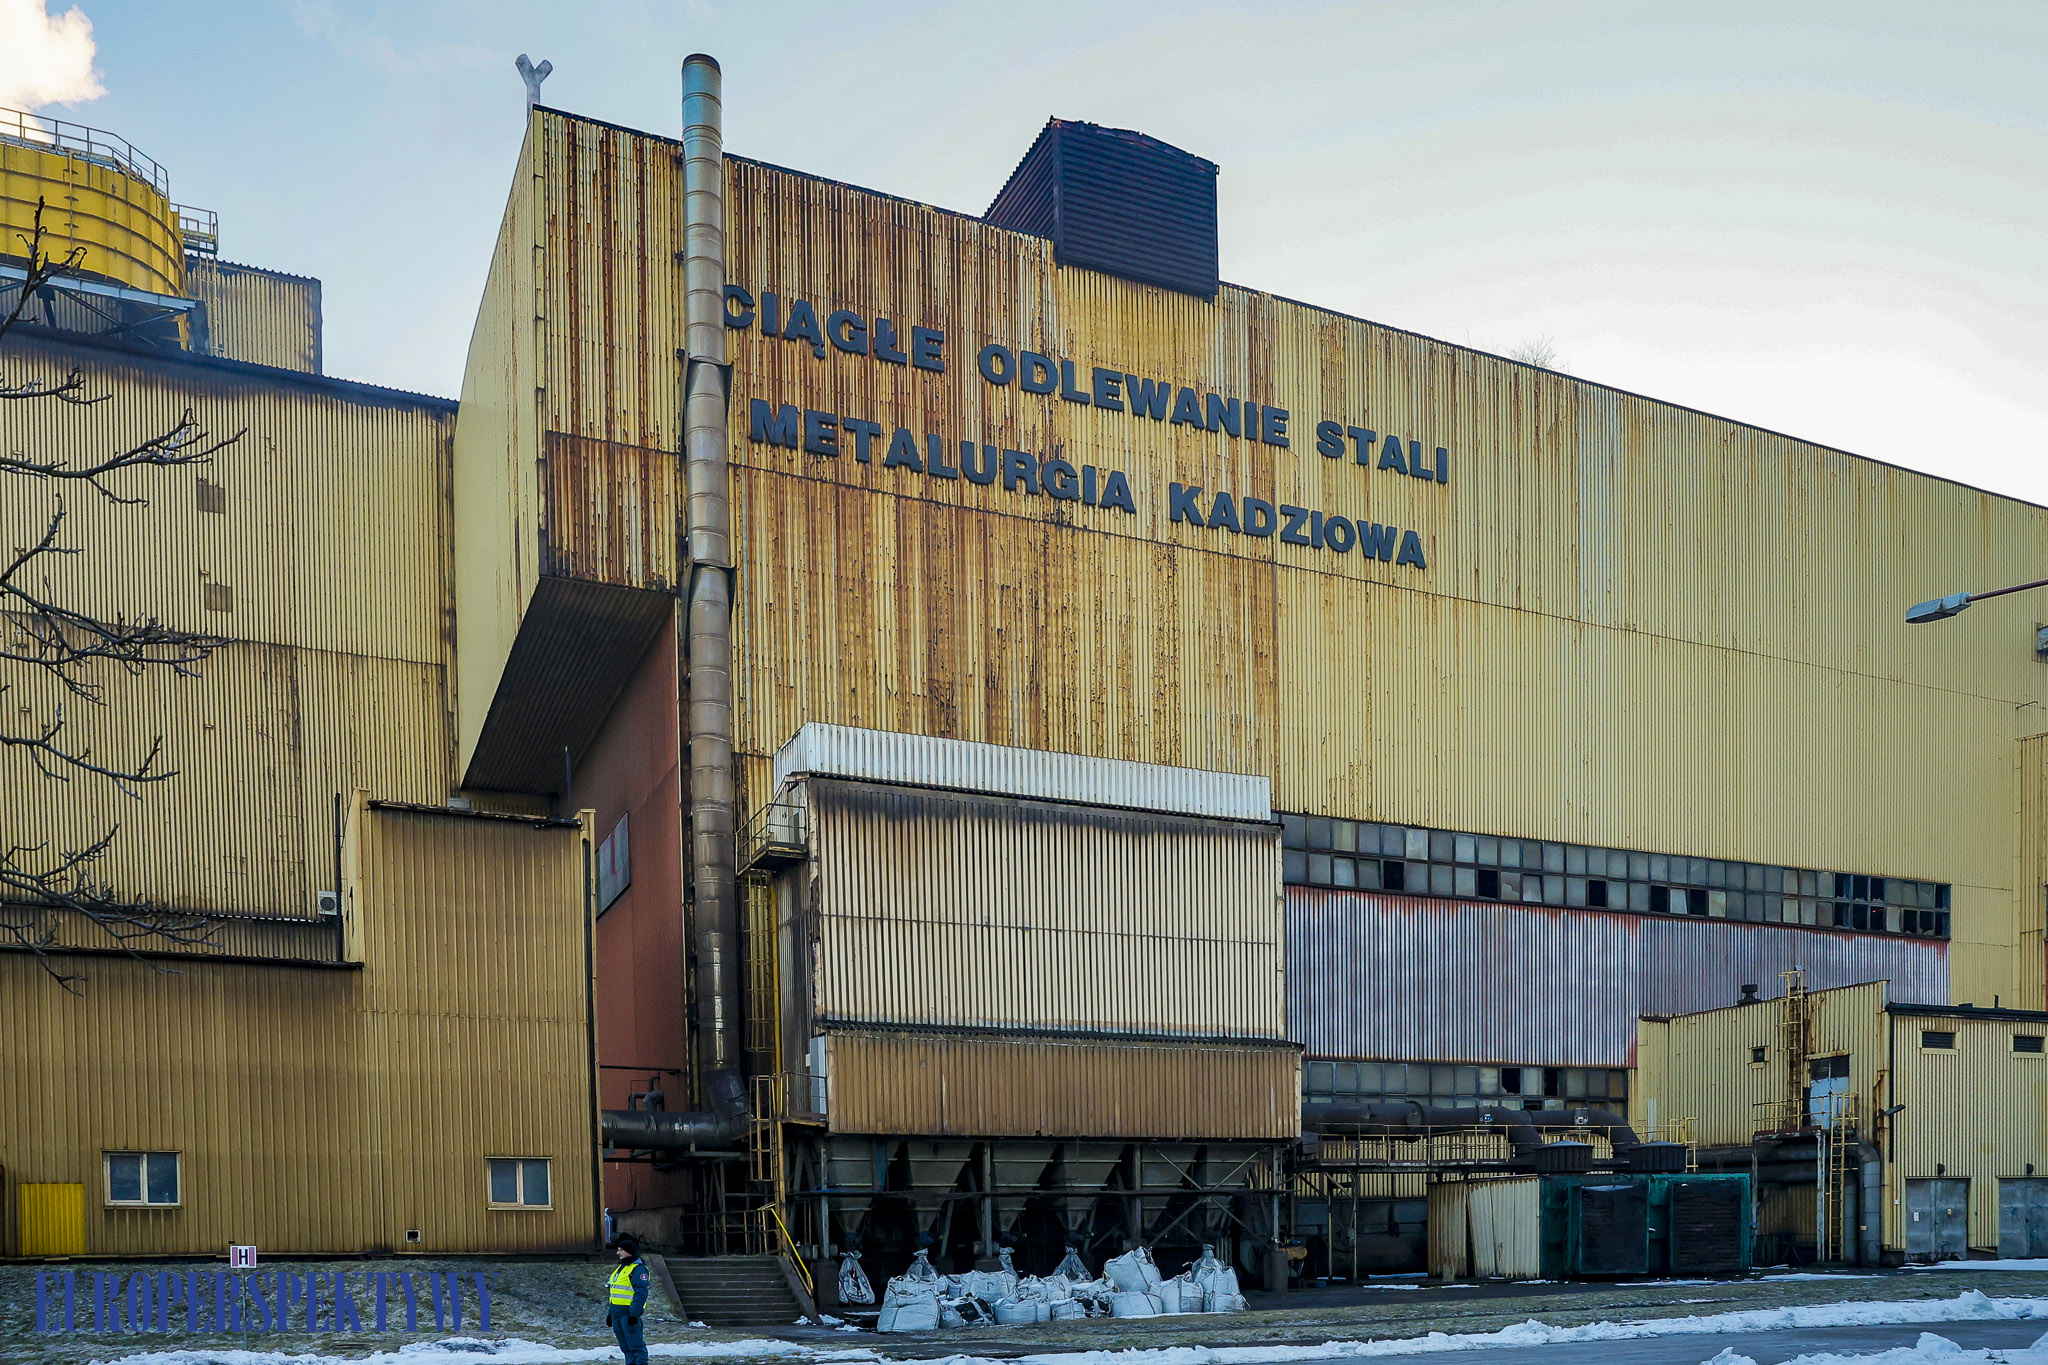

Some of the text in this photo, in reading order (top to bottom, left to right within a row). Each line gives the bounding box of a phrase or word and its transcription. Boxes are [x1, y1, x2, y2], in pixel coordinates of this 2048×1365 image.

[723, 284, 1448, 484] CIĄGŁE ODLEWANIE STALI
[750, 398, 1427, 569] METALURGIA KADZIOWA
[238, 1249, 248, 1265] H
